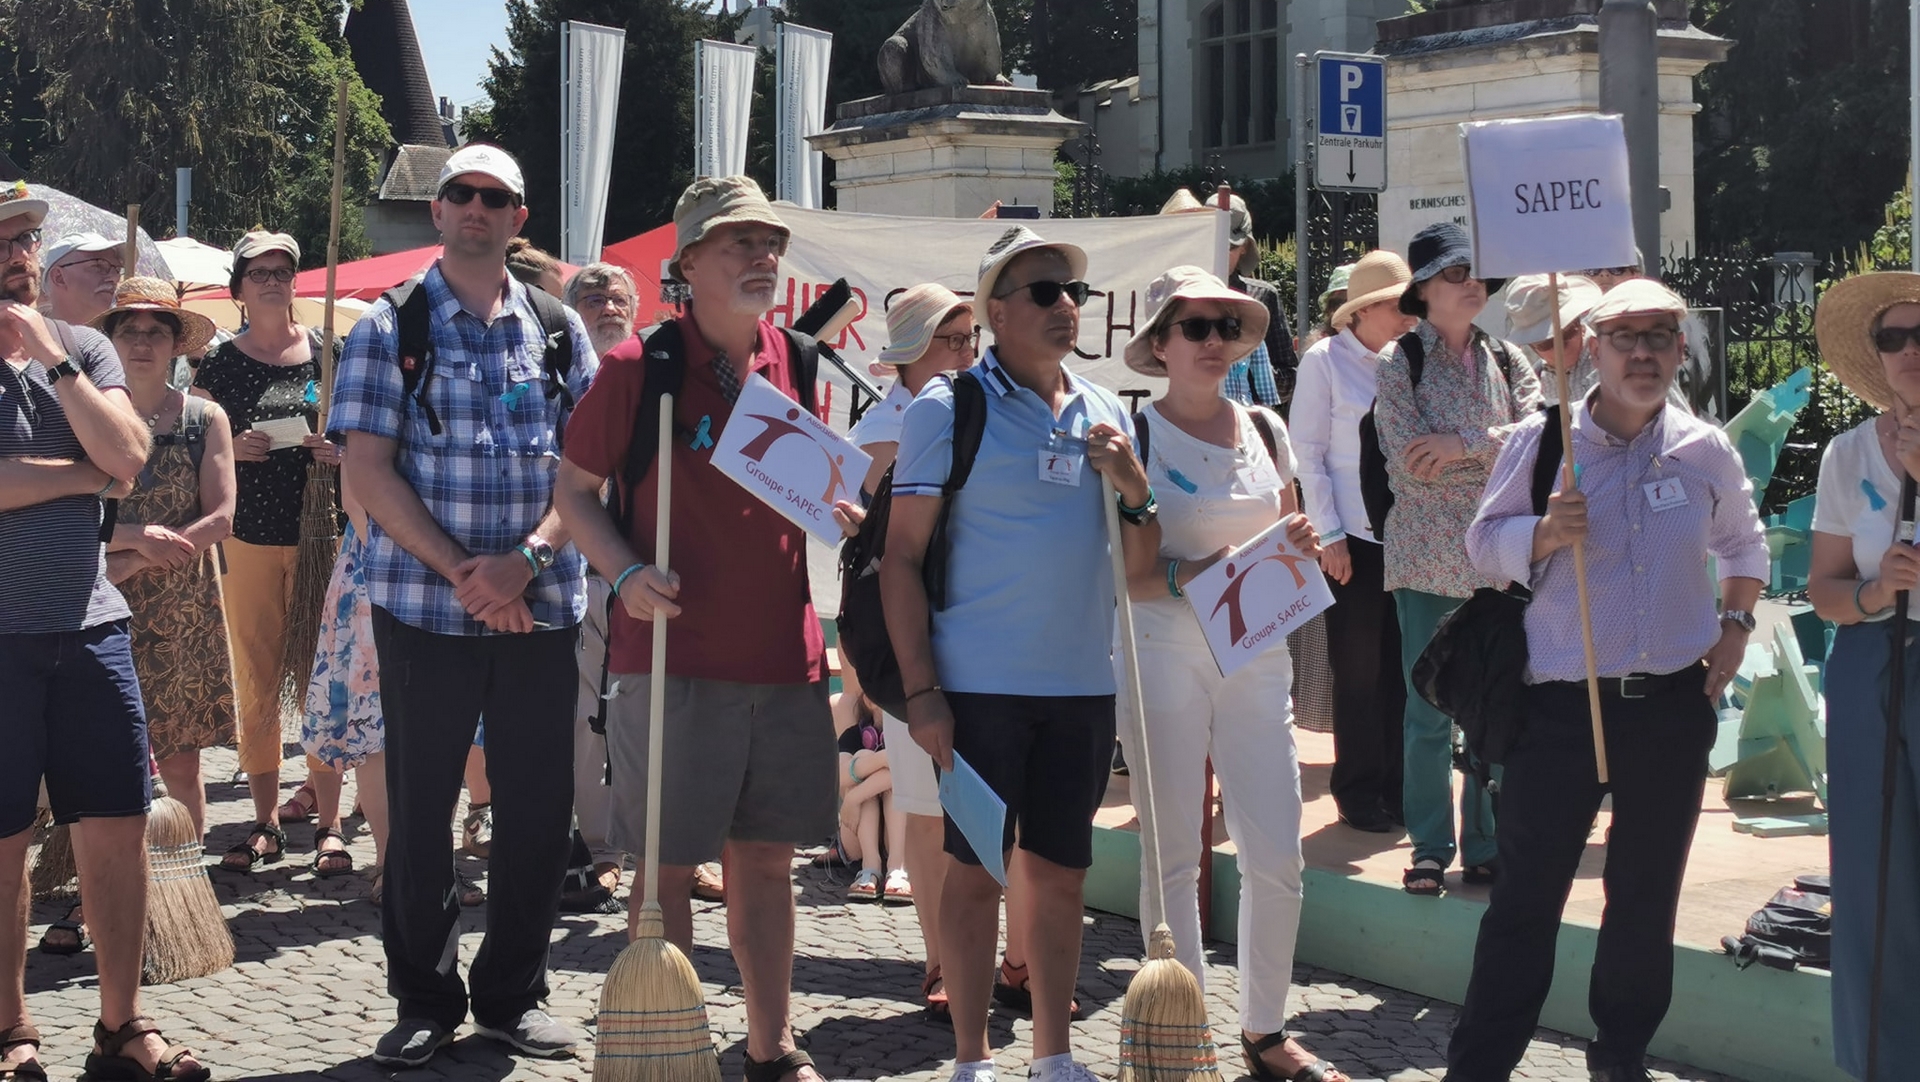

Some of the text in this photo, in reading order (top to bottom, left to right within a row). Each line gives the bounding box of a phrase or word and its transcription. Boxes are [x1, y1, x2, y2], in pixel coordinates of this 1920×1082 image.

[576, 47, 584, 89] Museum
[709, 64, 717, 104] Museum
[1340, 64, 1363, 102] P
[707, 106, 715, 163] Historisches
[1319, 136, 1383, 149] Zentrale Parkuhr
[1409, 195, 1466, 210] BERNISCHES
[1514, 178, 1602, 214] SAPEC
[806, 416, 840, 443] Association
[745, 461, 823, 521] Groupe SAPEC
[1239, 536, 1270, 560] Association
[1242, 595, 1312, 649] Groupe SAPEC
